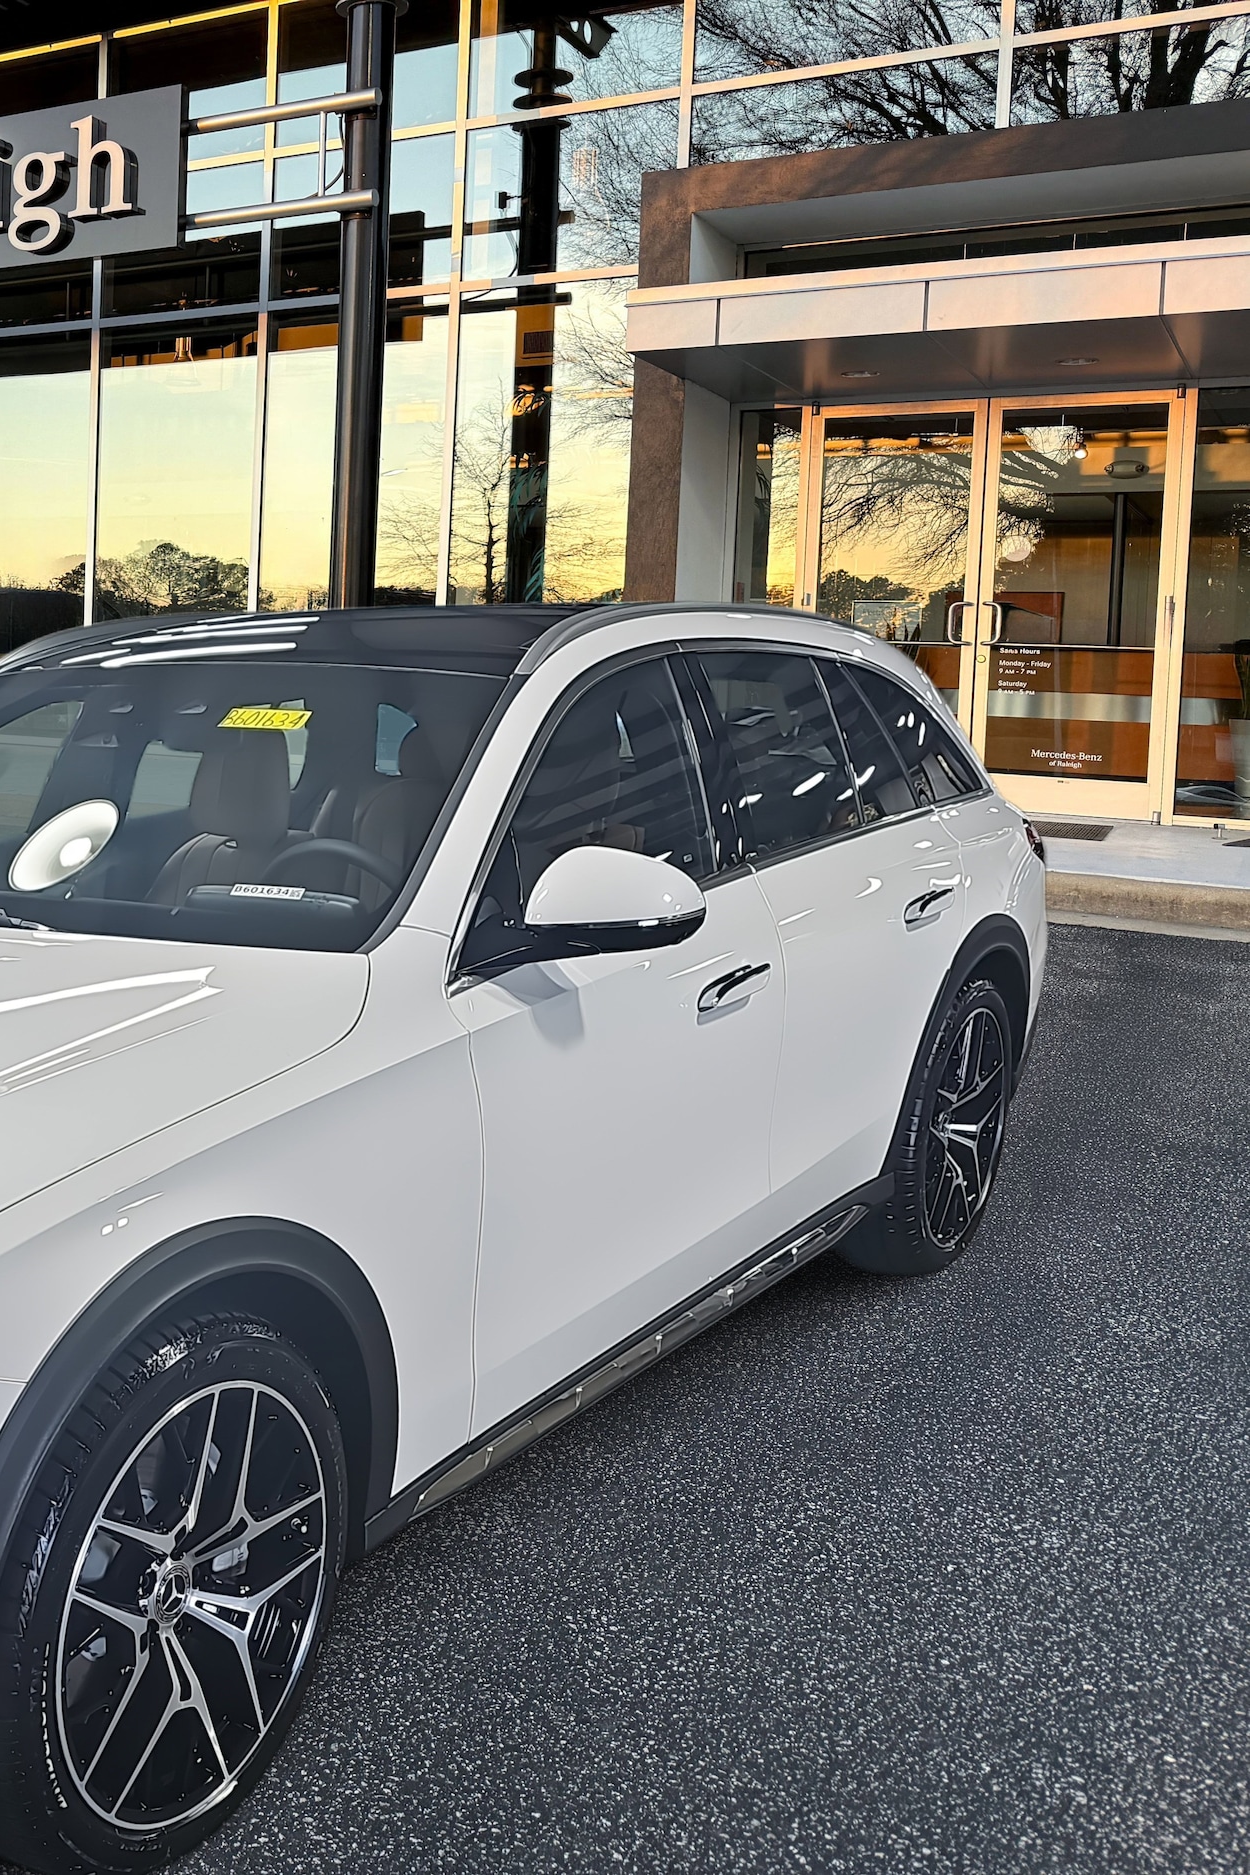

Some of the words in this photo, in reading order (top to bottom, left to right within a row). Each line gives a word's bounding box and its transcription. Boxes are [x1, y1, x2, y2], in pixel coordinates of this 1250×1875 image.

[998, 660, 1025, 668] Monday
[1031, 661, 1052, 669] Friday
[997, 680, 1028, 689] Saturday
[222, 709, 306, 728] B601634
[1031, 748, 1103, 762] Mercedes-Benz
[1057, 760, 1083, 769] Raleigh
[234, 885, 291, 896] B601634
